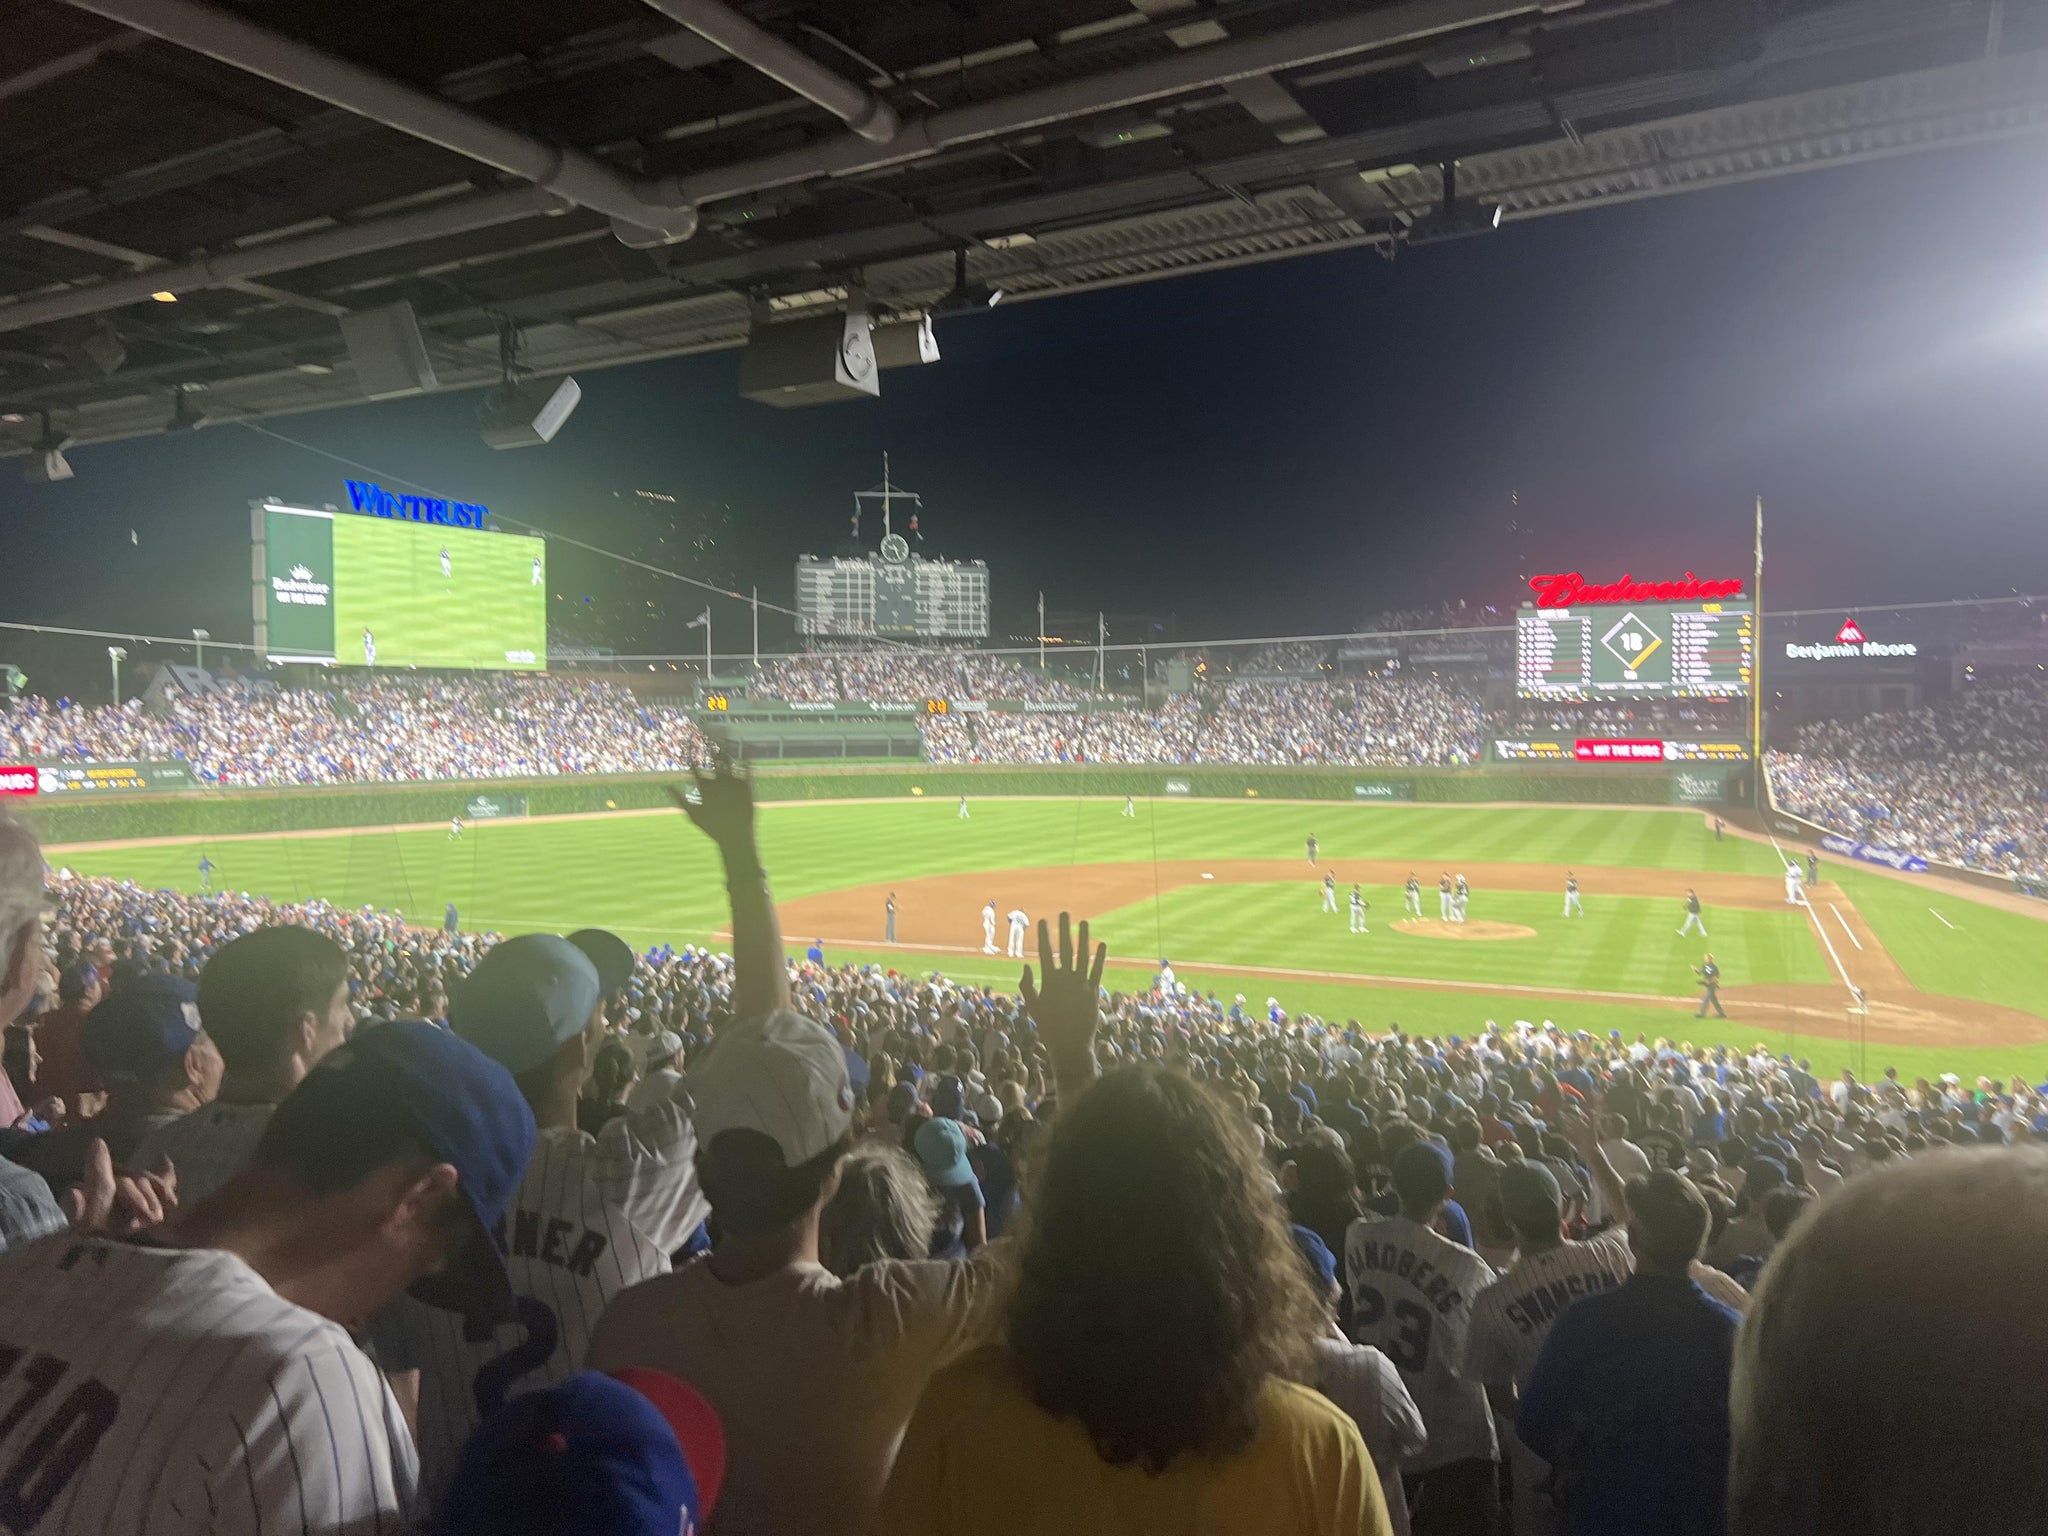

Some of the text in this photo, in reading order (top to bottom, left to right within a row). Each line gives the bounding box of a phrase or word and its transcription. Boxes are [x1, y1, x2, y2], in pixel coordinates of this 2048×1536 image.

[1529, 571, 1743, 609] Budweiser
[1786, 642, 1917, 661] Benjamin Moore
[1353, 1284, 1432, 1373] 23
